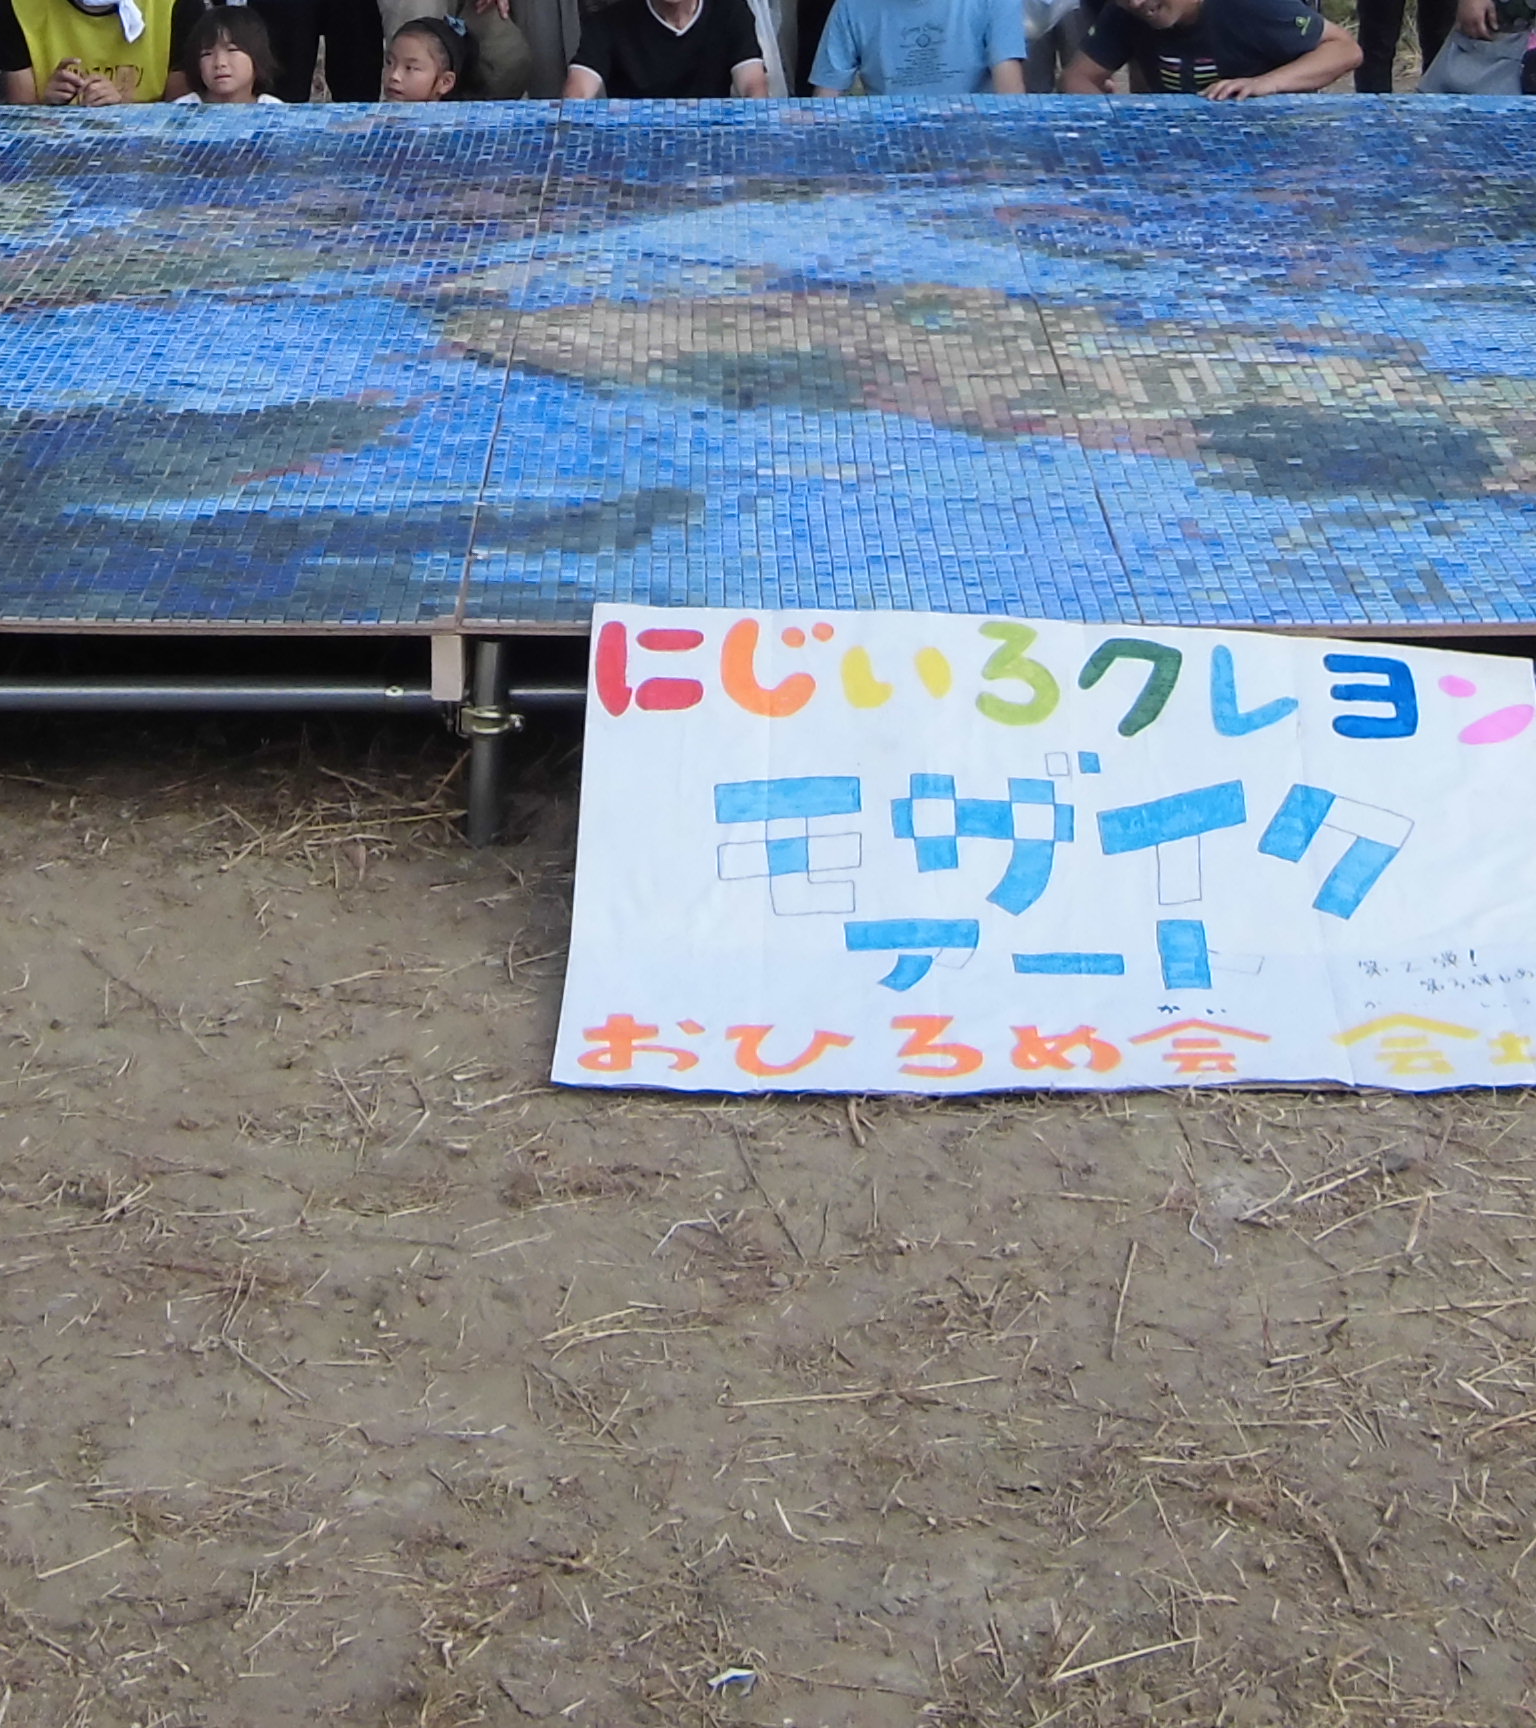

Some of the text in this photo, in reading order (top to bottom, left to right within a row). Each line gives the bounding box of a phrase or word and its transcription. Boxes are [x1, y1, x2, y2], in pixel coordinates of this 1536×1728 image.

[595, 617, 1535, 745] にじいろクレヨン
[714, 751, 1415, 919] モザイク
[844, 918, 1264, 992] アート
[576, 1012, 1272, 1078] おひろめ会
